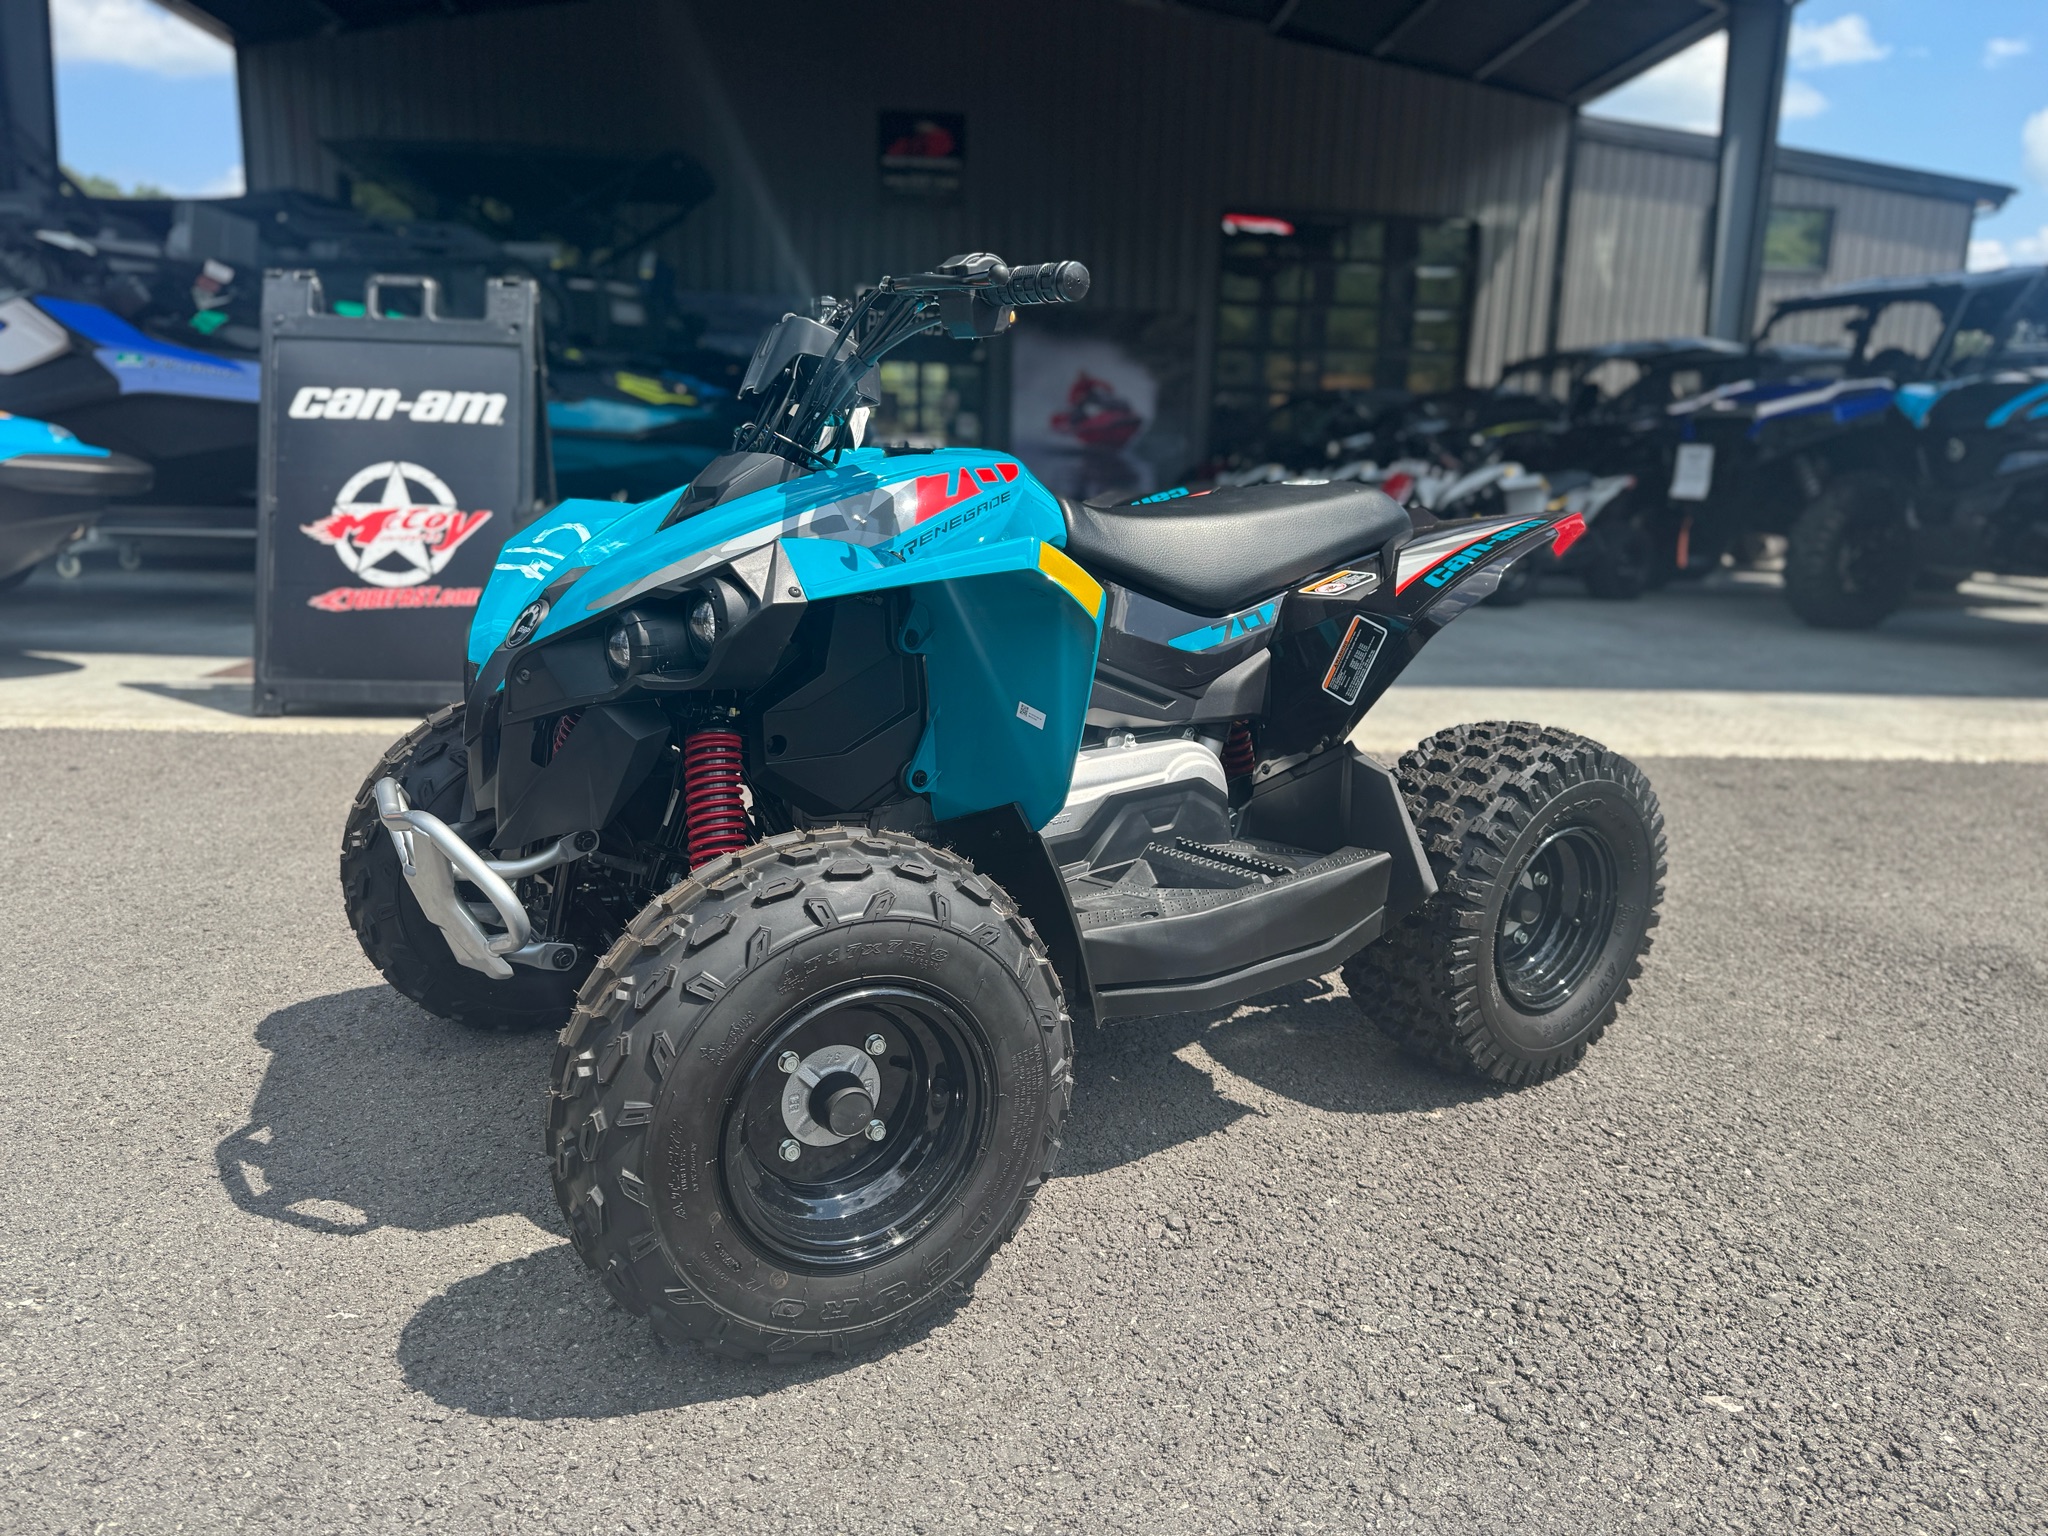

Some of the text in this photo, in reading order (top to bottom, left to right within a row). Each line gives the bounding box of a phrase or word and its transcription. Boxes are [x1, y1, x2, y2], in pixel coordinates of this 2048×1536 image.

[288, 386, 507, 425] can-am
[305, 506, 493, 554] McCoy
[901, 490, 1012, 557] RENEGADE
[1423, 519, 1549, 588] can-am
